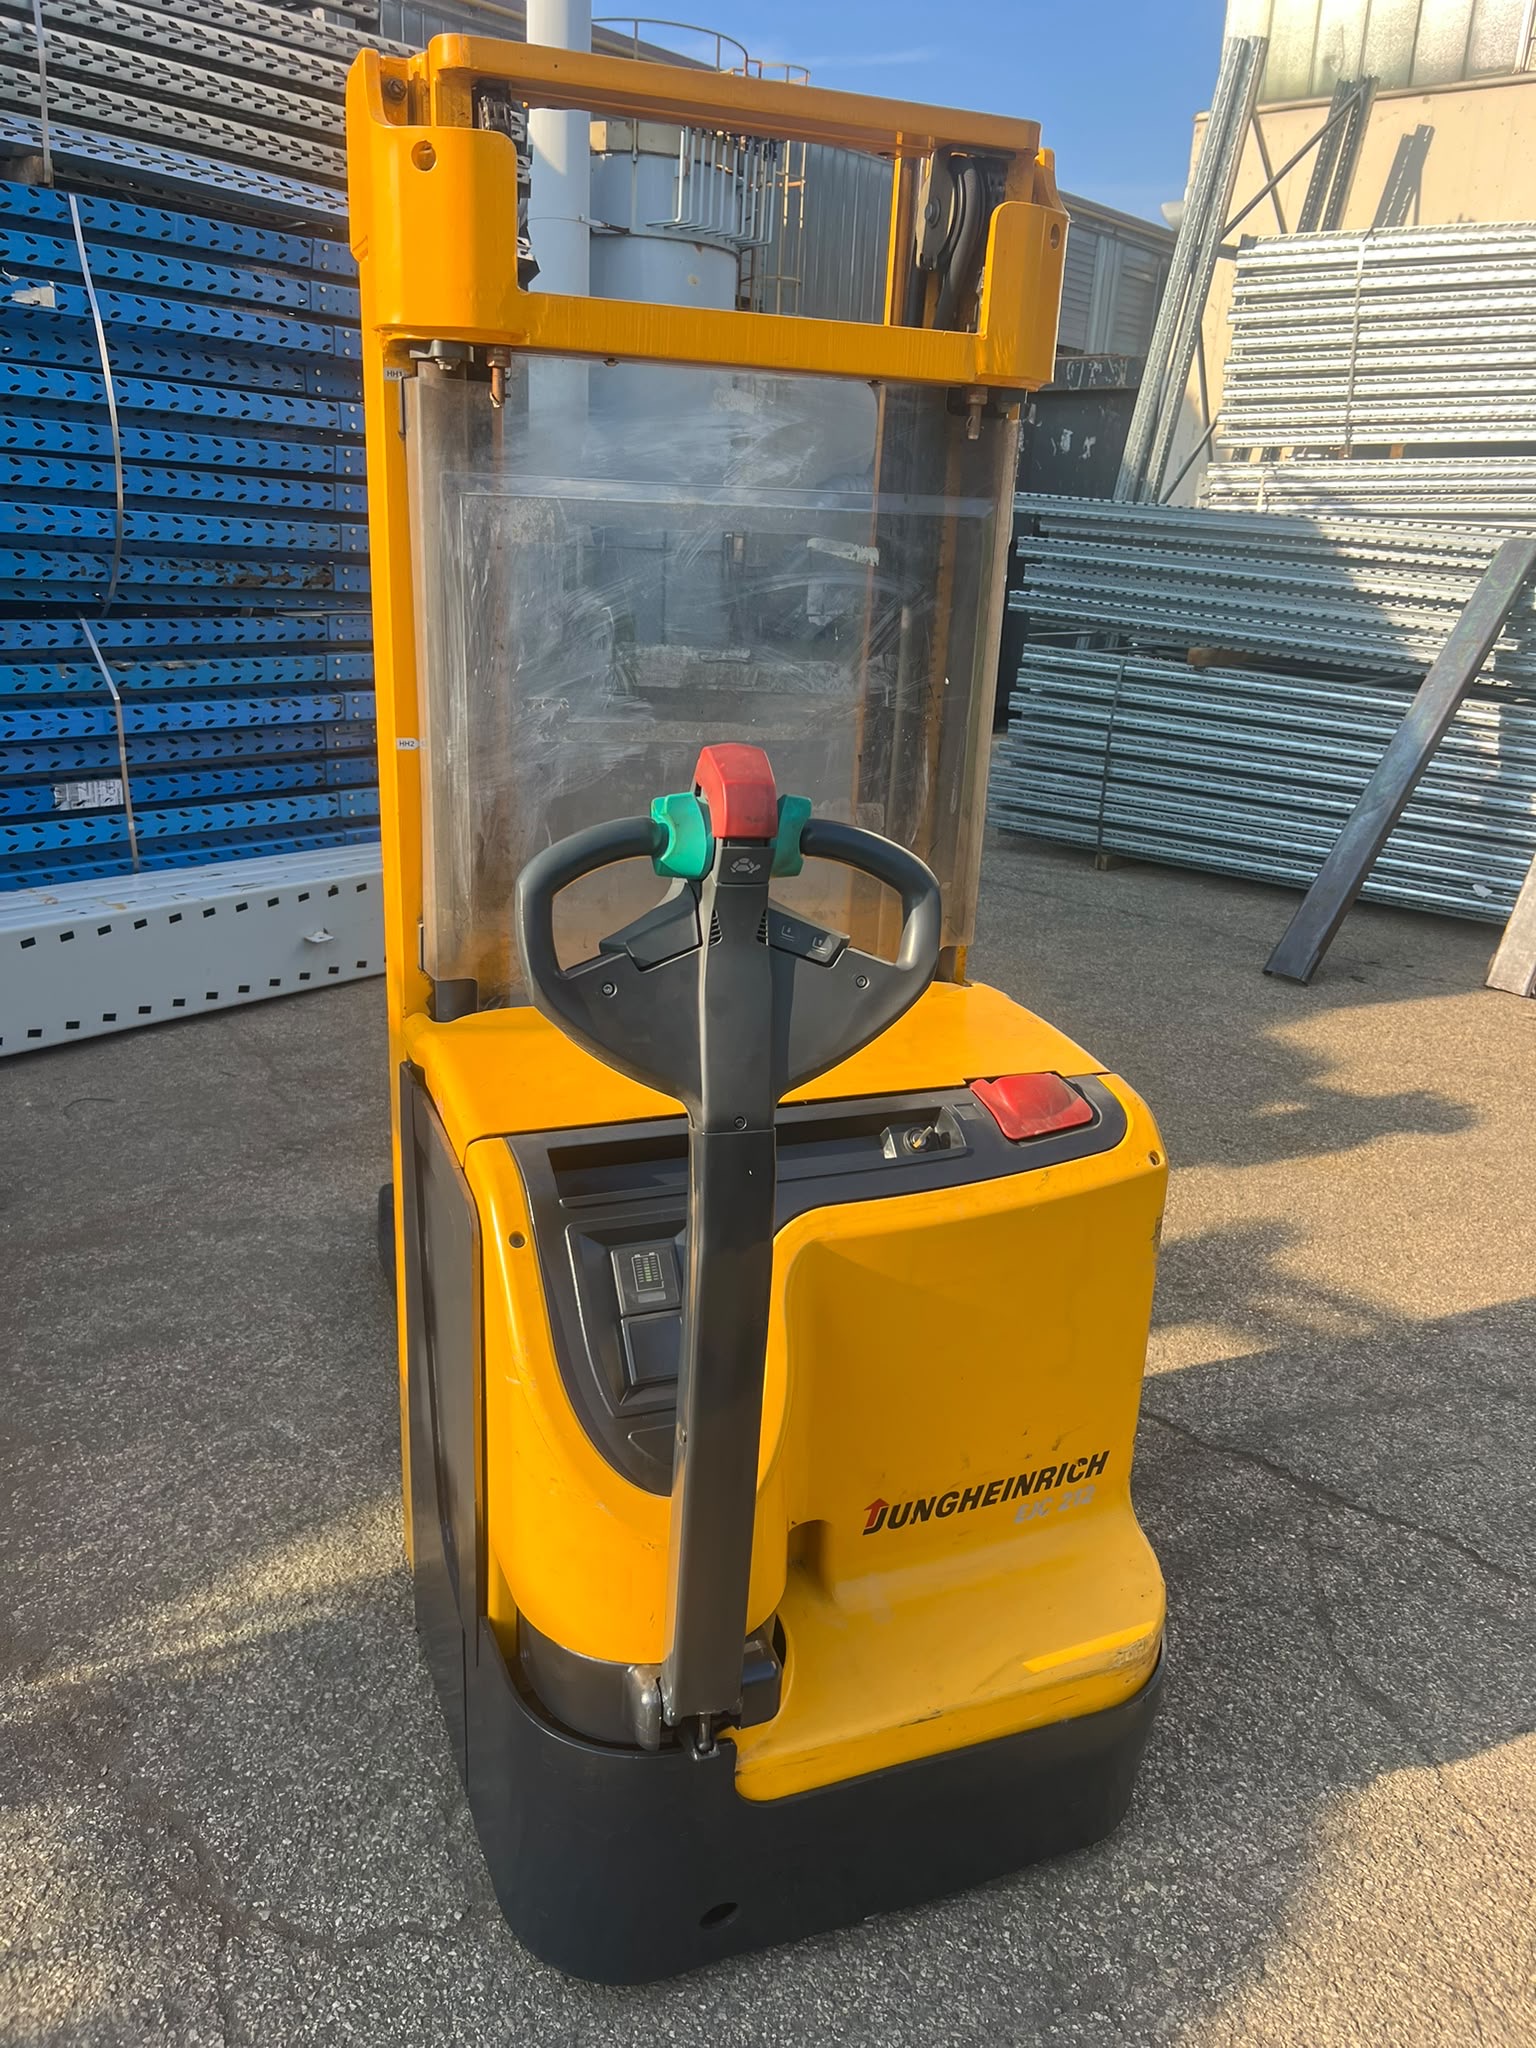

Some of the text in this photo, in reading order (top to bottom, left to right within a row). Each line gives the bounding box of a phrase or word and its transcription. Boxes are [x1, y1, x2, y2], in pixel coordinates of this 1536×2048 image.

[862, 1450, 1110, 1536] JUNGHEINRICH
[1014, 1484, 1095, 1525] EJC 212
